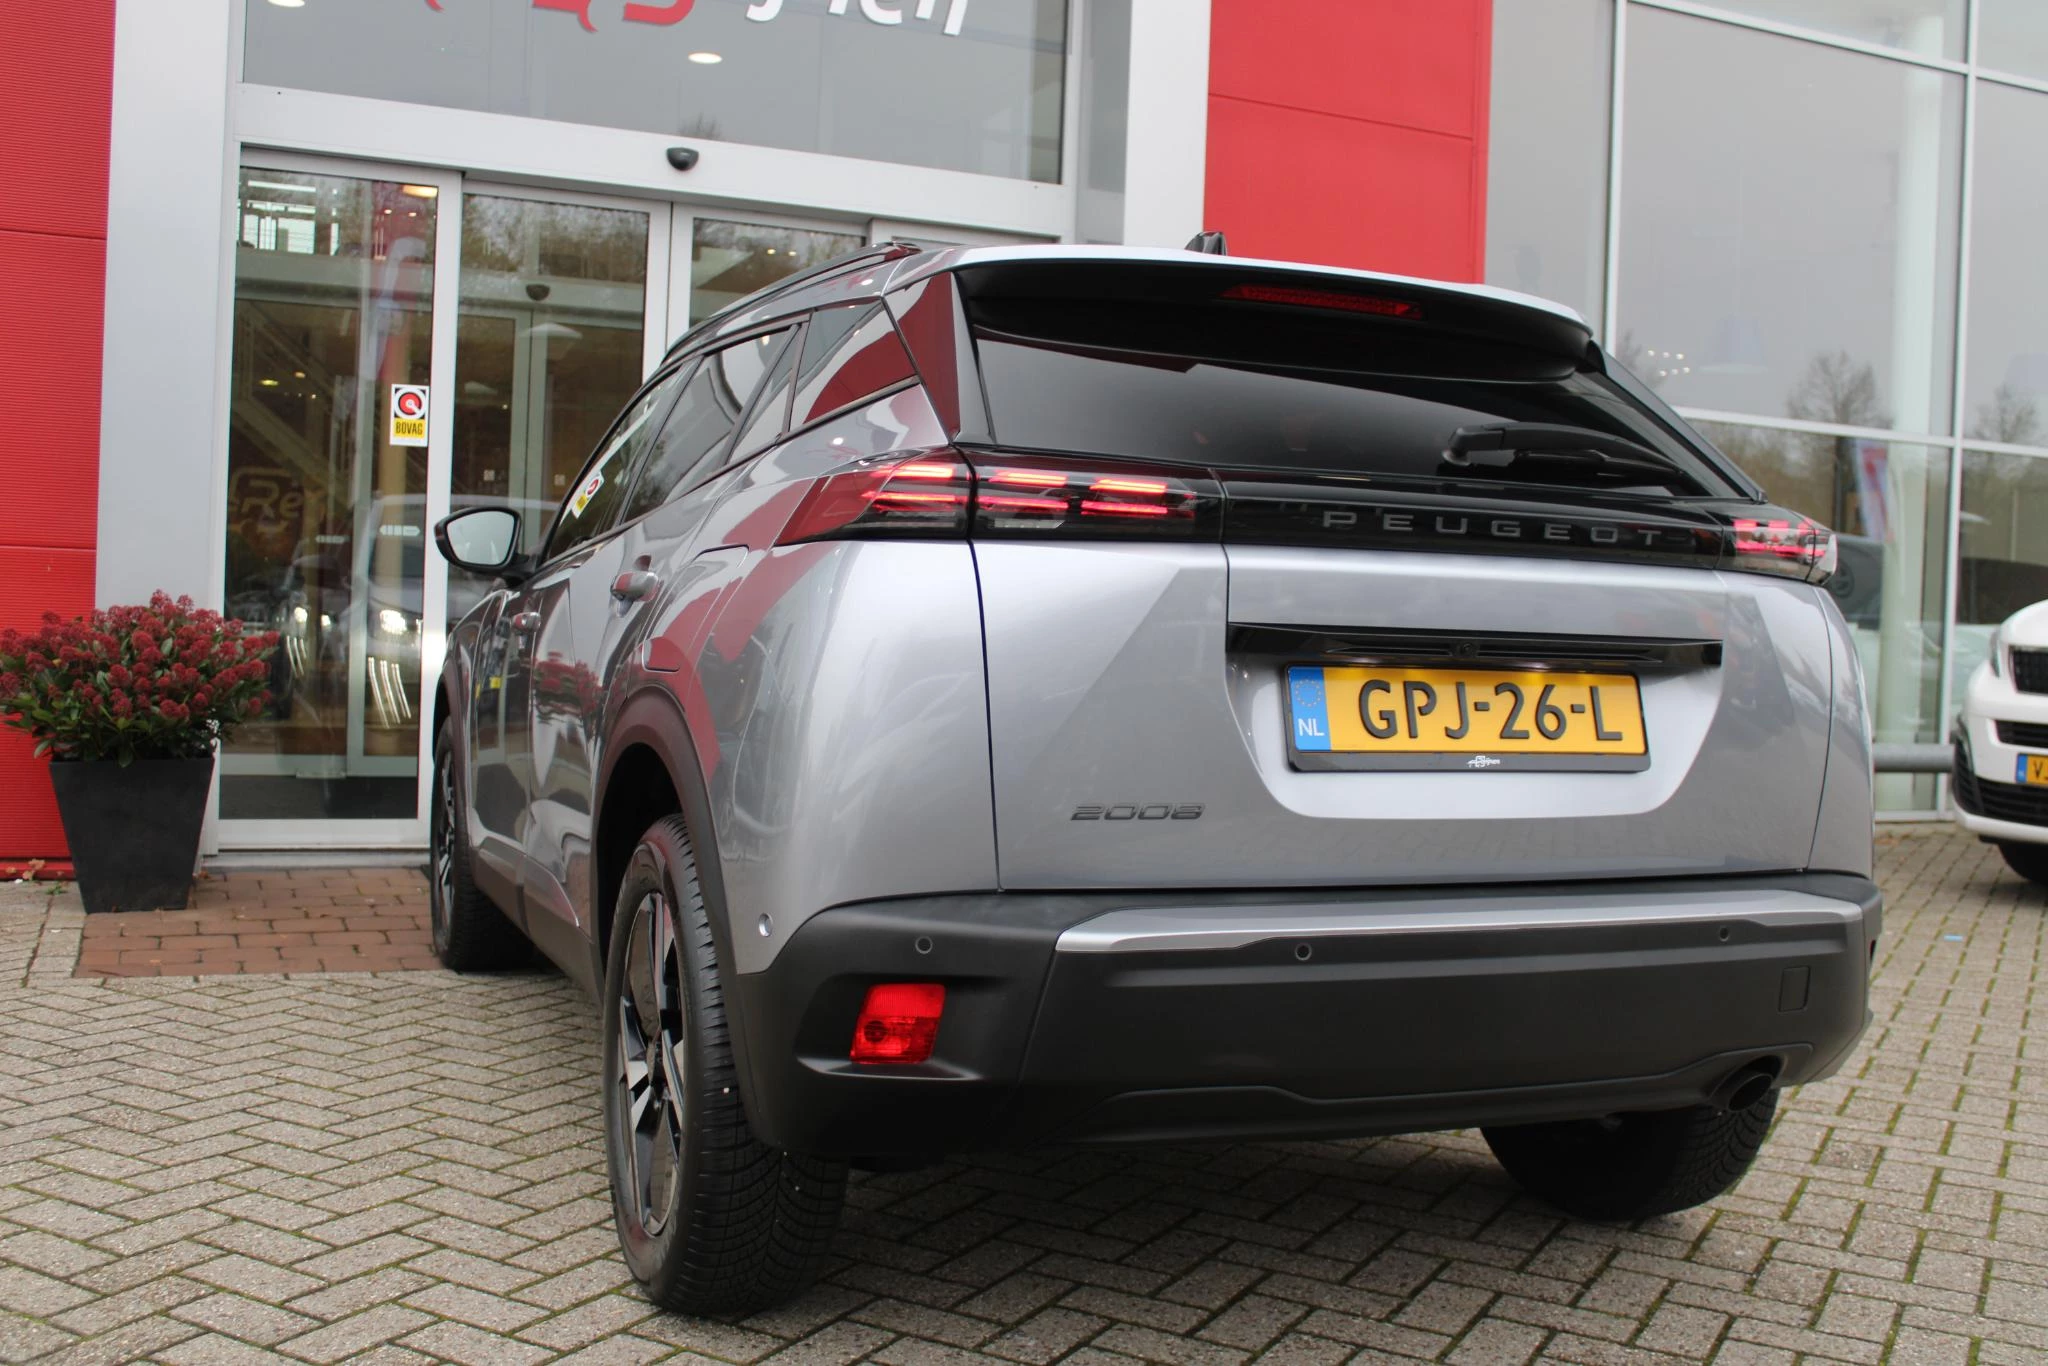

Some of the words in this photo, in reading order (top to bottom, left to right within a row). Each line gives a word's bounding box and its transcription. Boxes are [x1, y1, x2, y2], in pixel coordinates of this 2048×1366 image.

[395, 421, 423, 436] BOVAG
[1322, 510, 1661, 546] PEUGEOT
[1358, 679, 1623, 742] GPJ-26-L
[1297, 718, 1325, 738] NL
[1070, 804, 1206, 821] 2008
